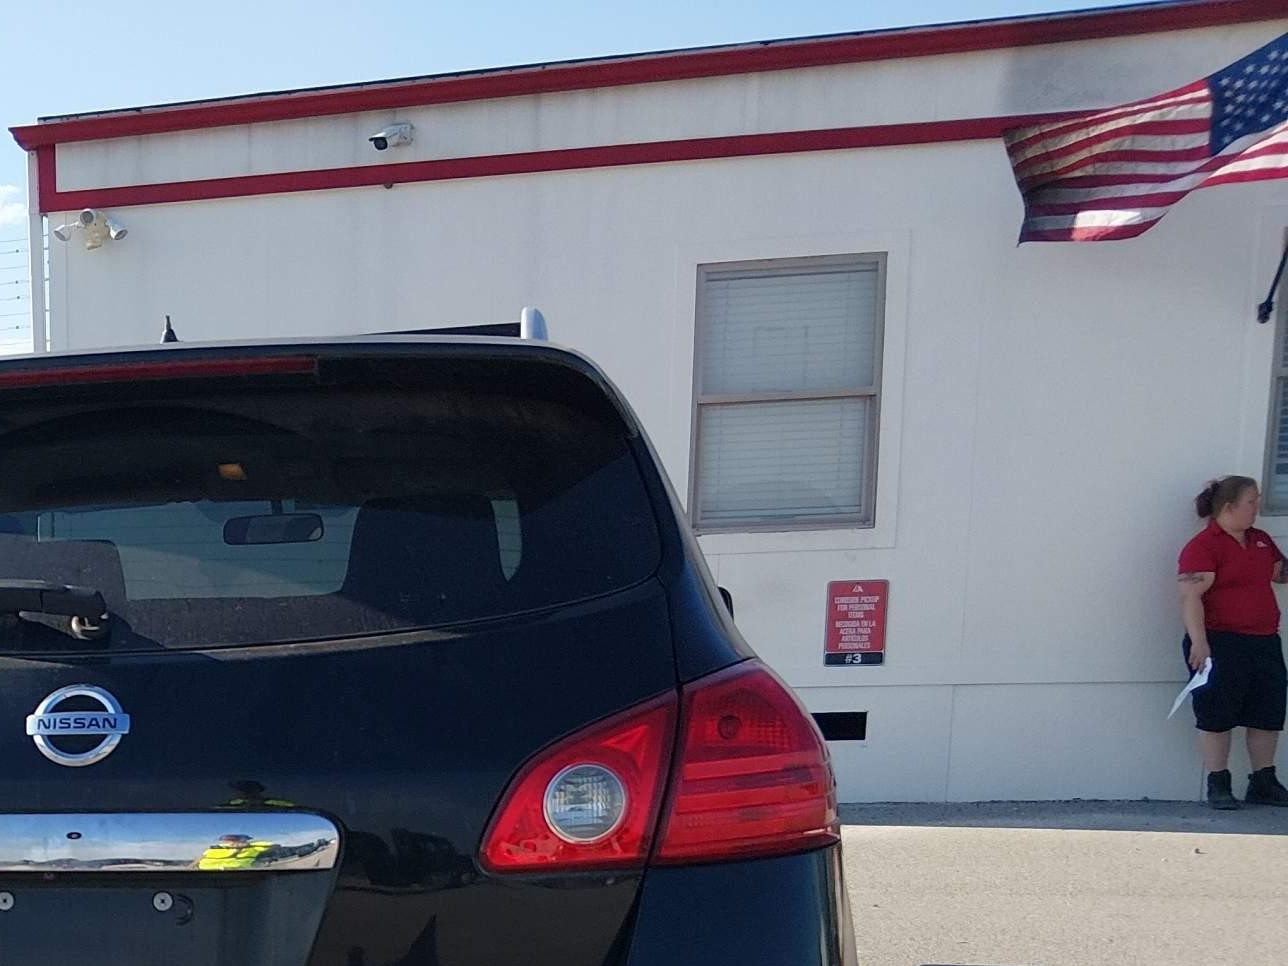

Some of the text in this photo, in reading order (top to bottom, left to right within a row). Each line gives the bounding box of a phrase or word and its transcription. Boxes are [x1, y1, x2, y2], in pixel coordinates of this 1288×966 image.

[860, 595, 880, 603] PICKUP
[838, 642, 871, 650] PERSONALES
[845, 653, 862, 664] #3
[37, 717, 117, 730] NISSAN
